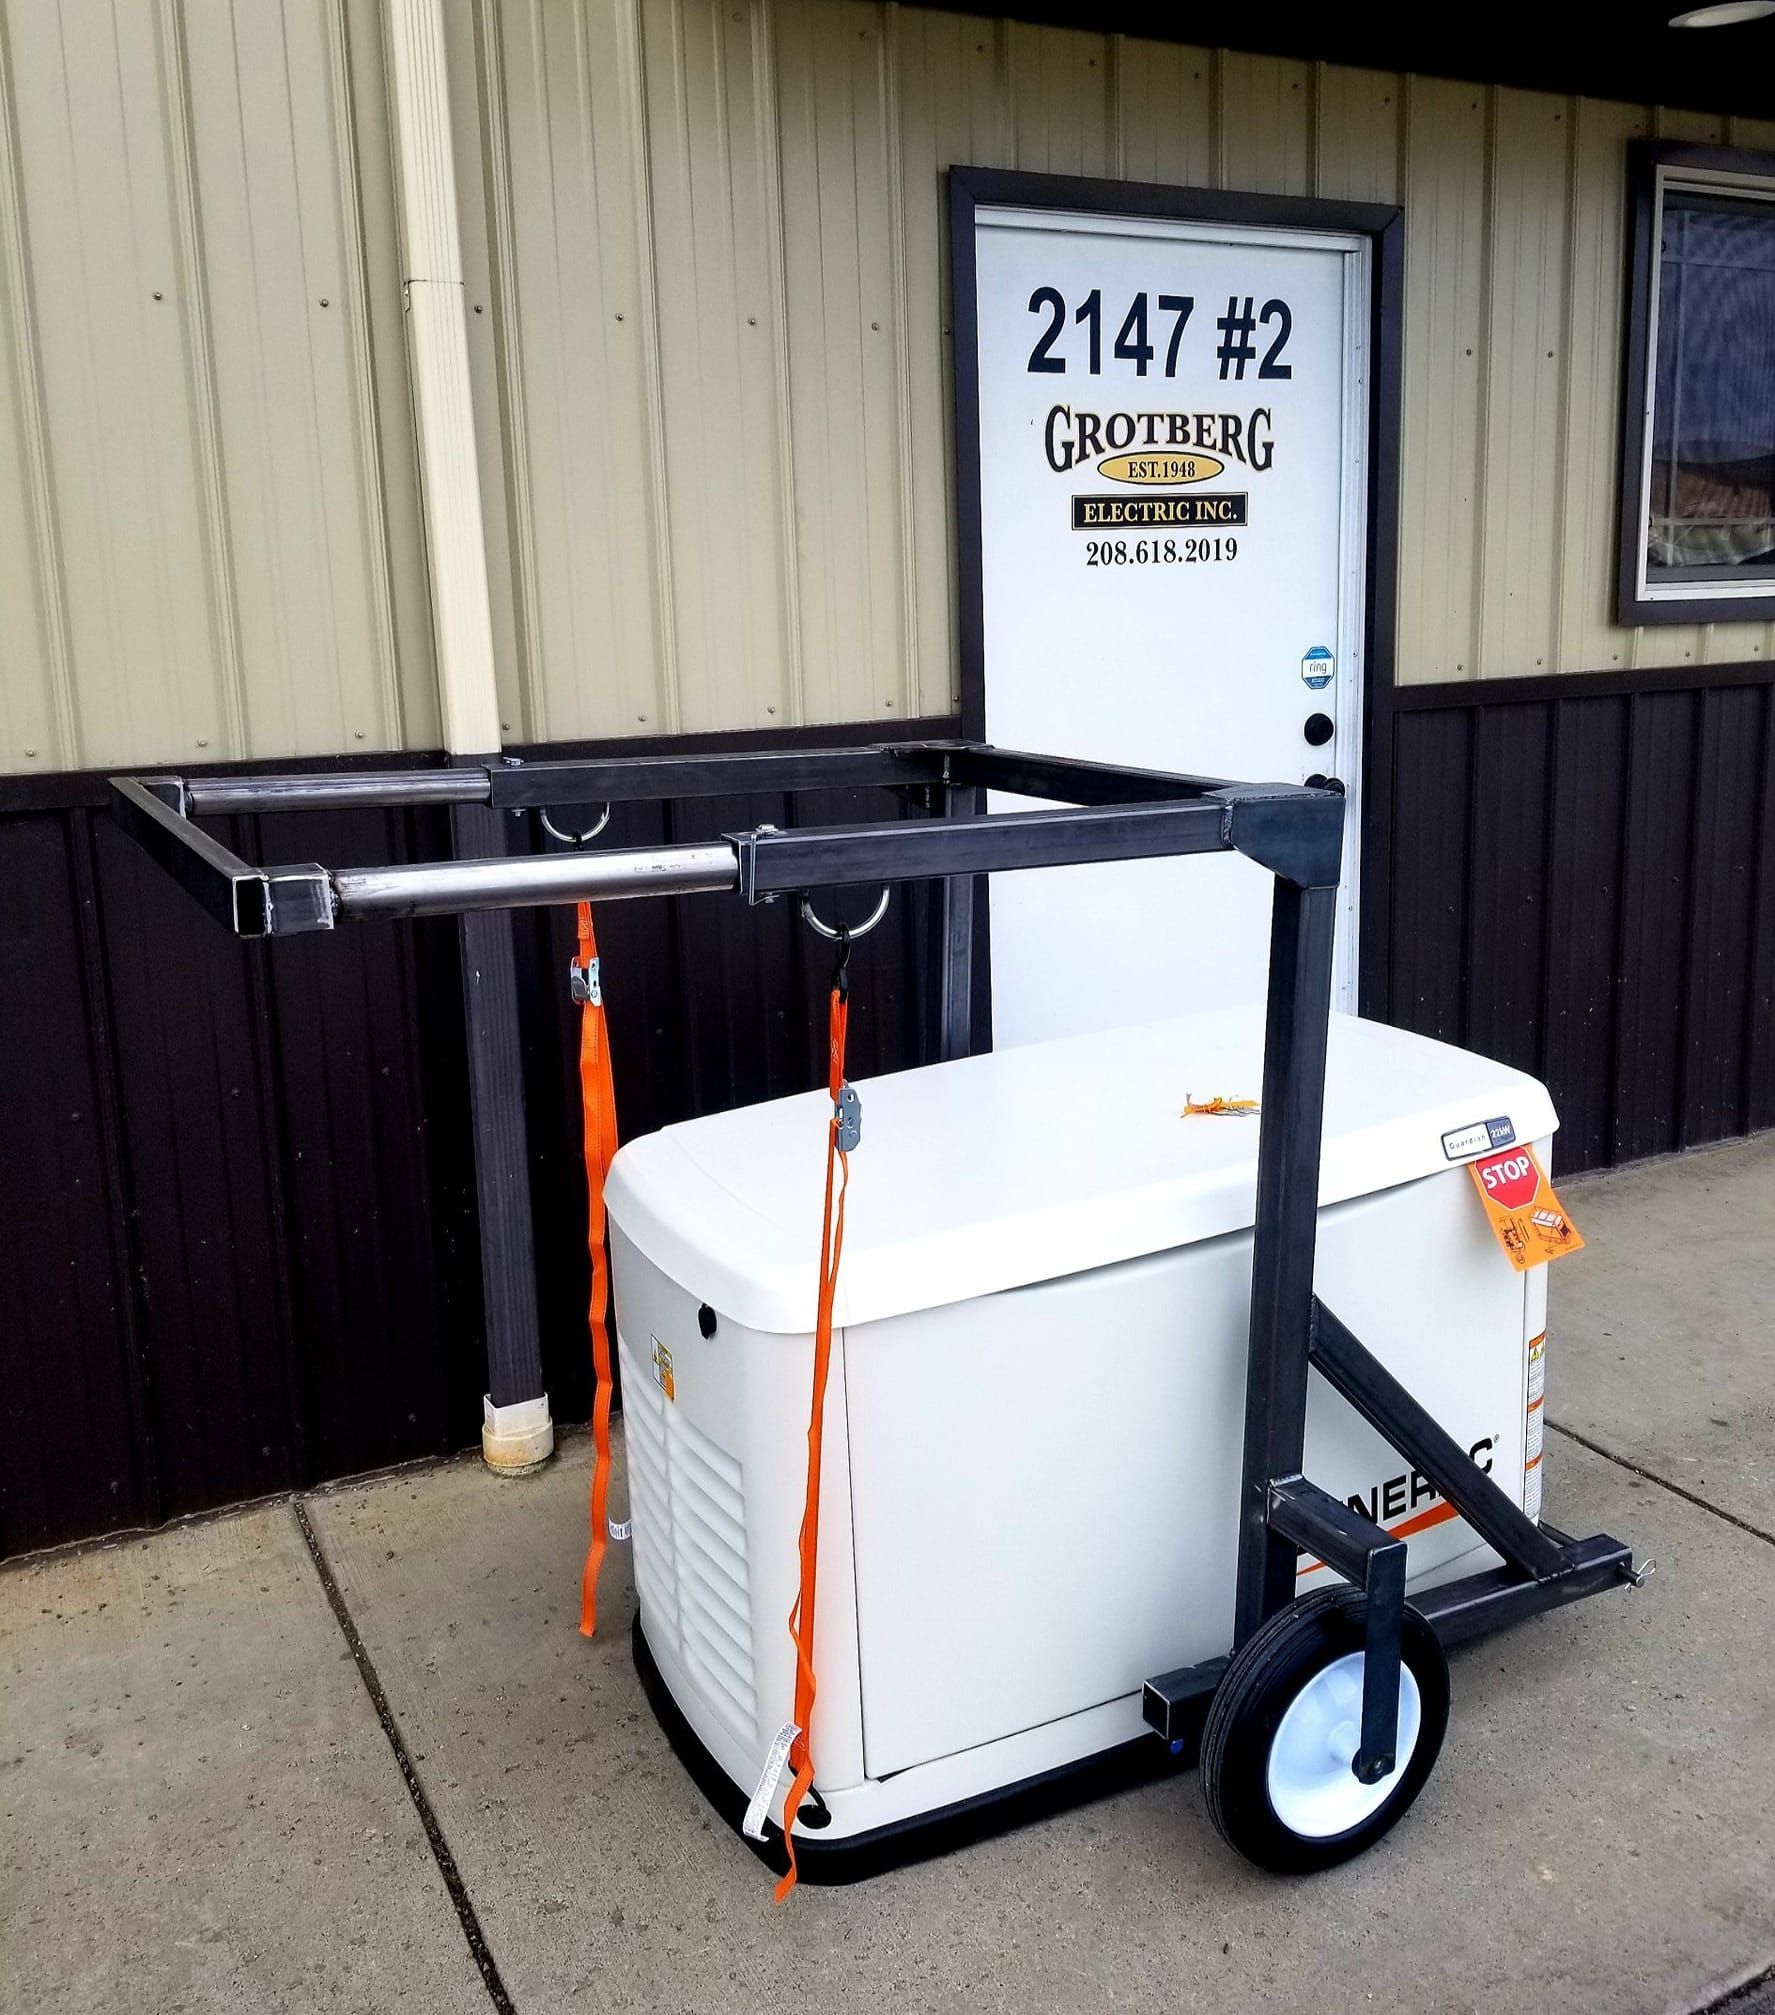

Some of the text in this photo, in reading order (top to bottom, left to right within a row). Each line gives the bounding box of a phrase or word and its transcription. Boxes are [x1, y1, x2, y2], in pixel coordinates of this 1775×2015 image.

[1027, 286, 1292, 380] 2147 #2
[1045, 404, 1274, 472] GROTBERG
[1128, 461, 1196, 479] EST.1948
[1083, 500, 1237, 523] ELECTRIC INC.
[1086, 537, 1238, 567] 208.618.2019
[1309, 661, 1327, 674] ring
[1482, 1156, 1531, 1190] STOP
